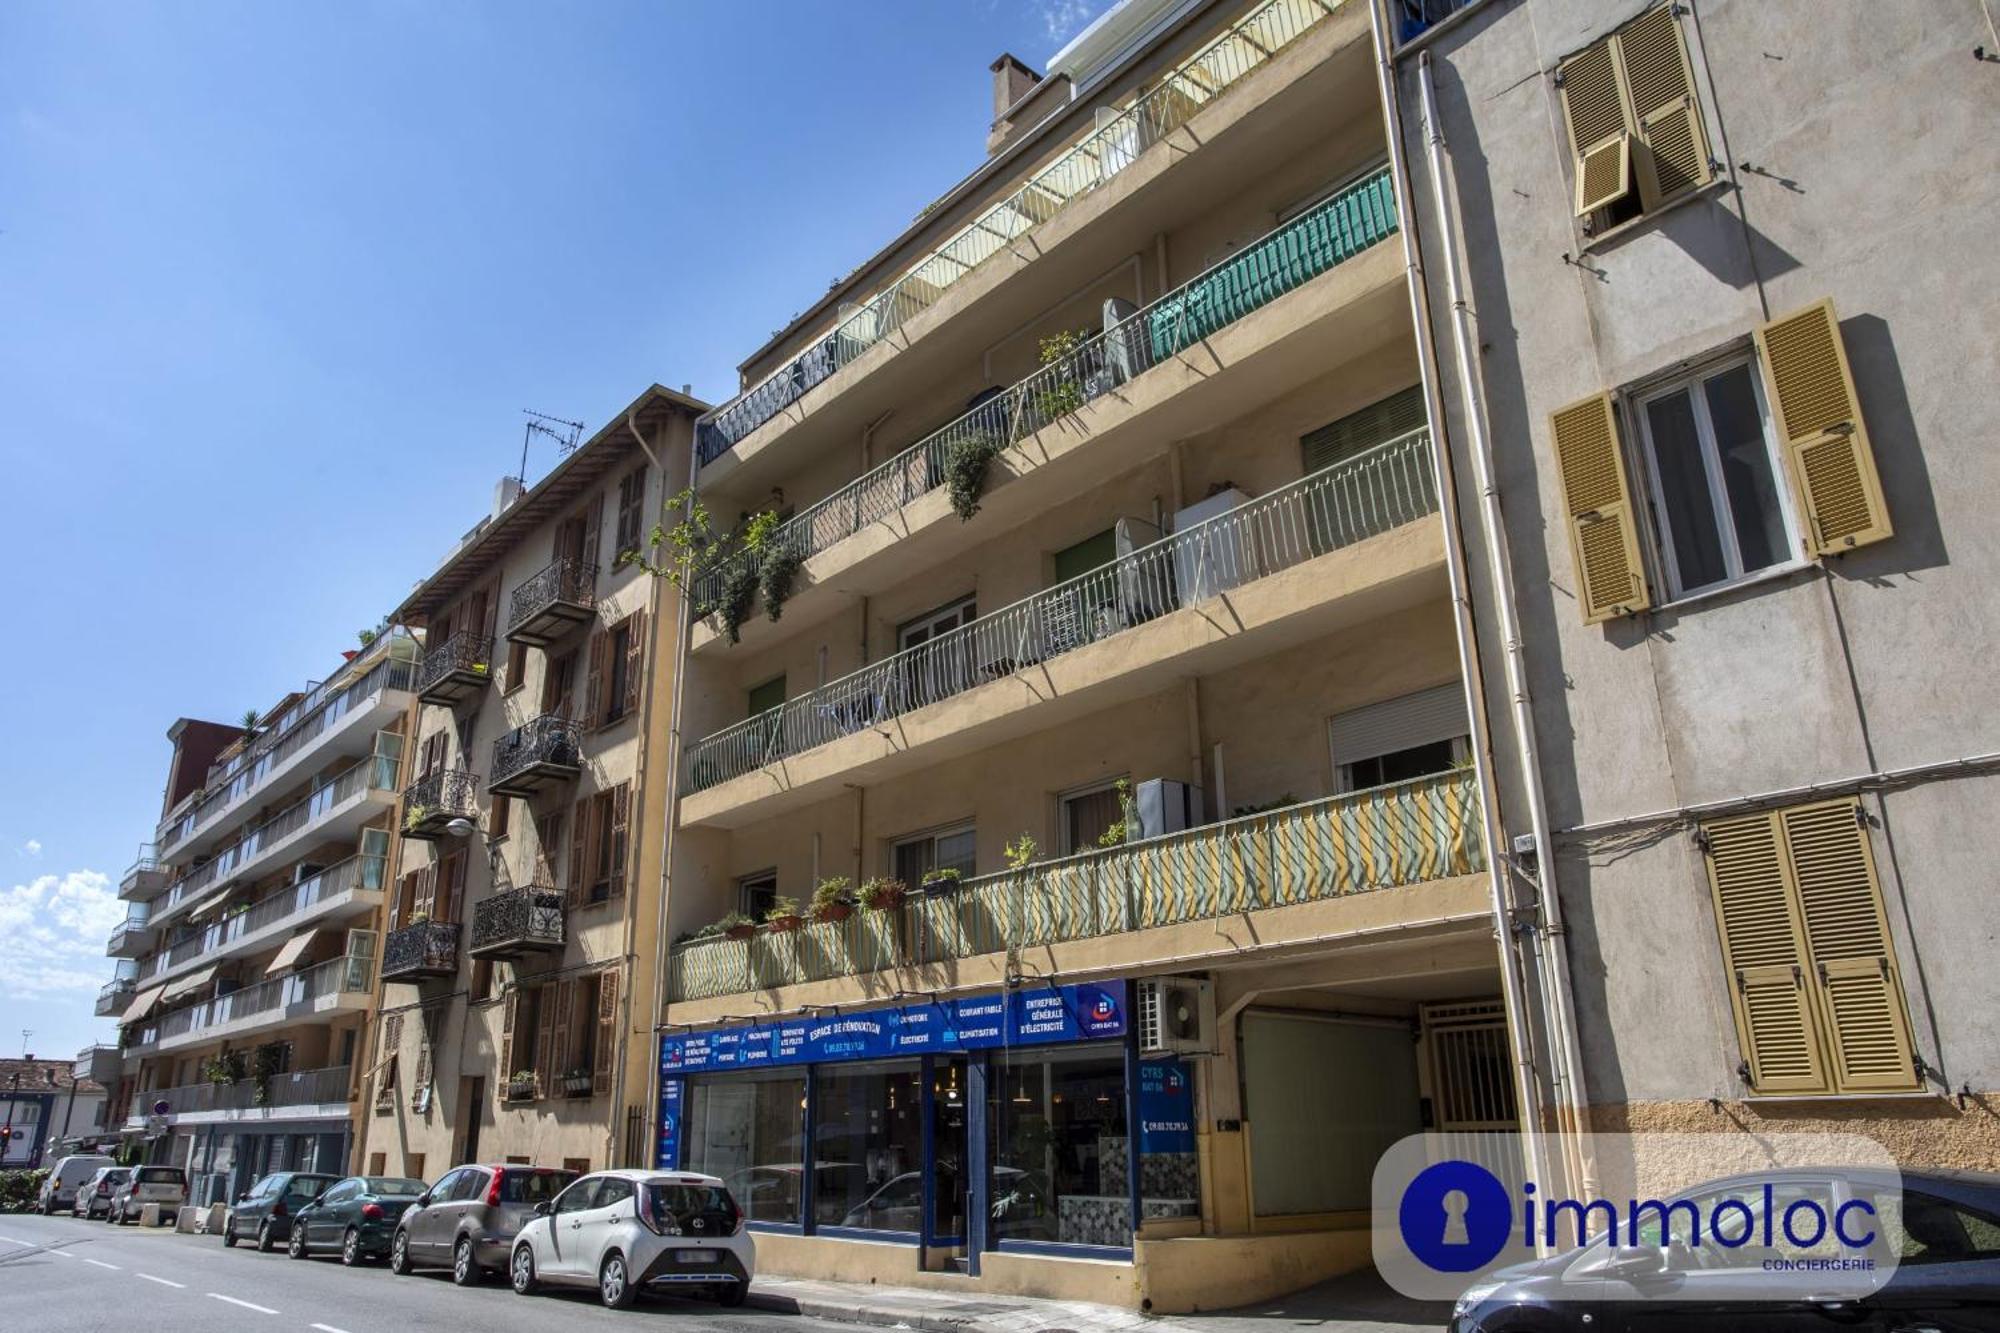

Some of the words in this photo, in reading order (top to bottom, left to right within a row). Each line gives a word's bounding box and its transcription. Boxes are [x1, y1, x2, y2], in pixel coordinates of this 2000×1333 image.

[1026, 997, 1063, 1010] ENTREPRISE
[959, 1007, 984, 1017] COURANT
[984, 1004, 1003, 1014] FAIBLE
[1031, 1009, 1064, 1021] GÉNÉRALE
[810, 1025, 832, 1041] ESPACE
[833, 1022, 842, 1034] DE
[842, 1019, 881, 1035] RÉNOVATION
[959, 1028, 999, 1039] CLIMATISATION
[1020, 1021, 1064, 1034] D'ÉLECTRICITÉ
